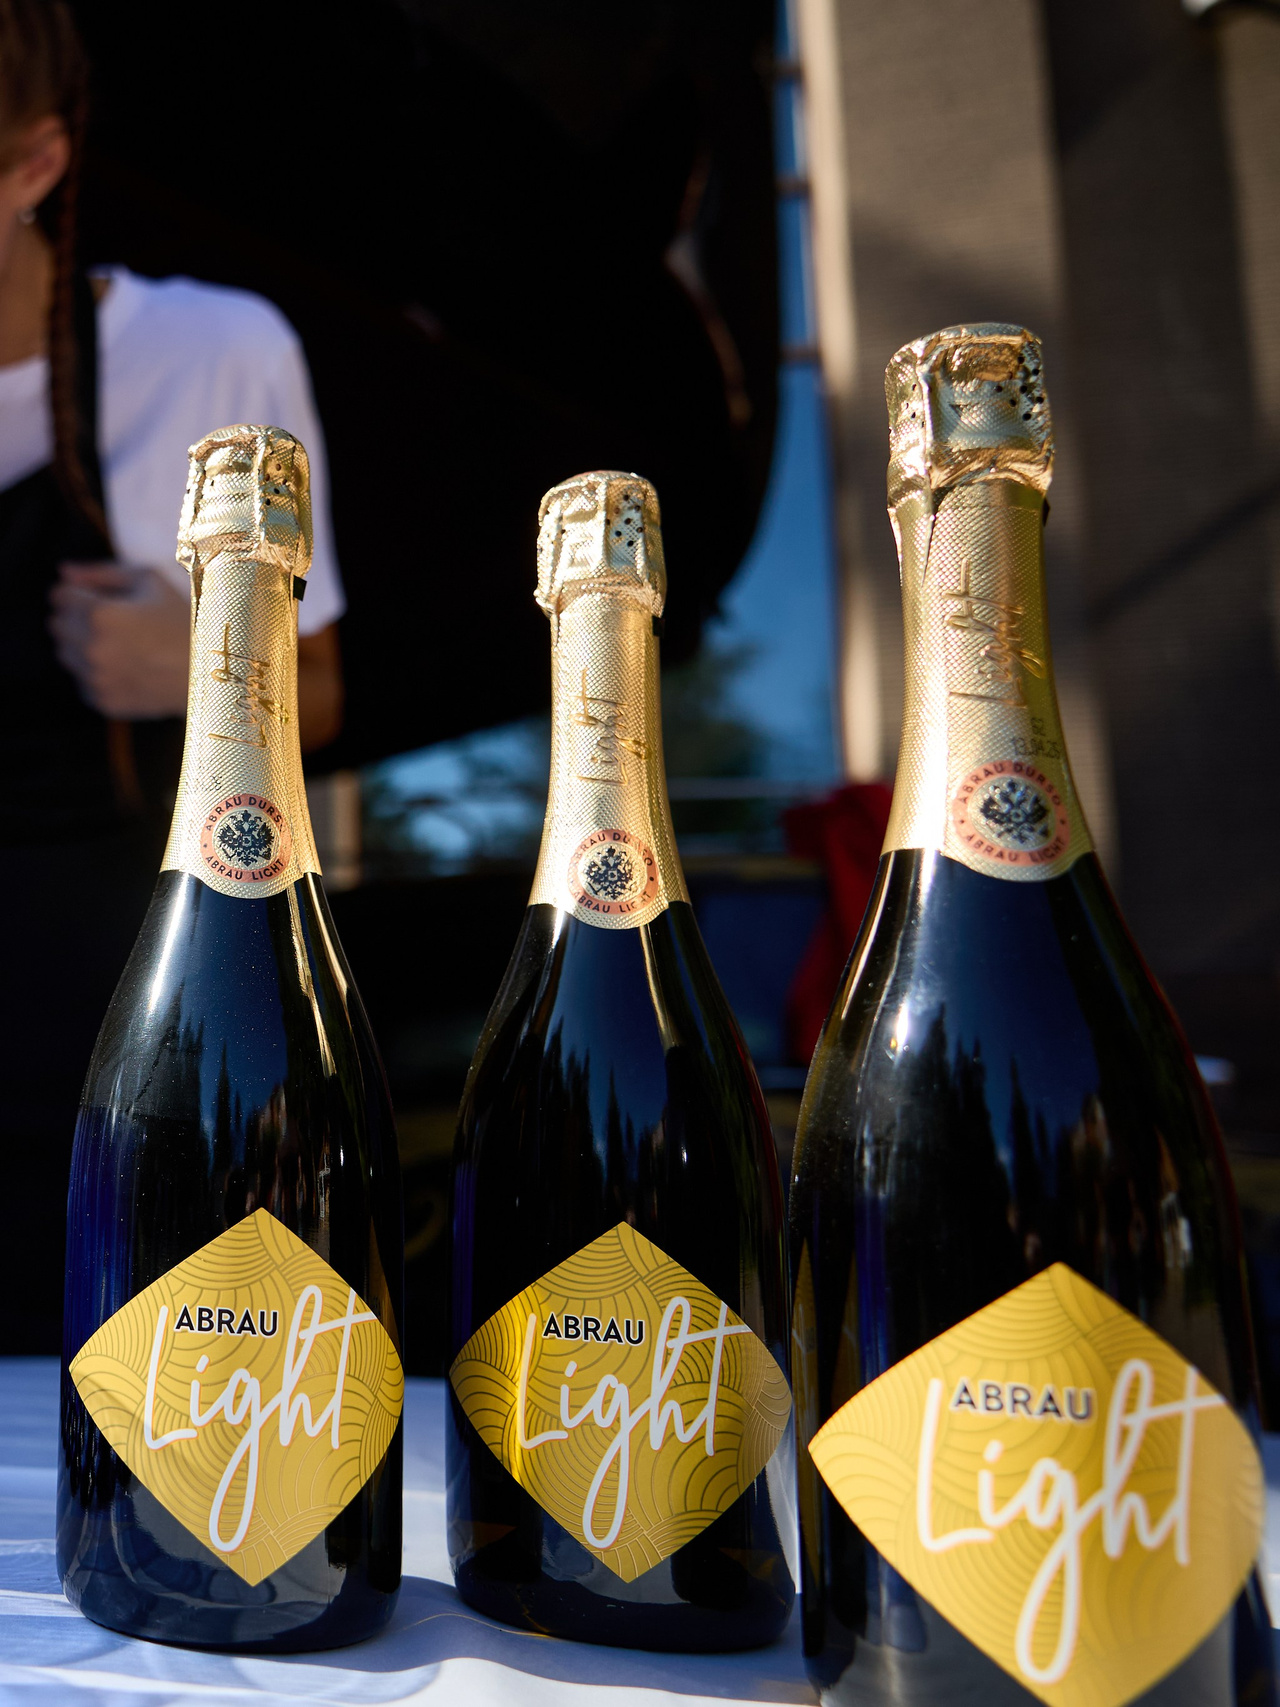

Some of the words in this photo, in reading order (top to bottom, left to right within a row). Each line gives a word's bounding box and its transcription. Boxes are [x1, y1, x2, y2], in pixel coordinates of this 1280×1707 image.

[959, 762, 1005, 804] ABRAU
[206, 796, 242, 831] ABRAU
[249, 796, 283, 832] DURS
[572, 833, 606, 867] BRAU
[612, 832, 654, 866] DUSO
[966, 834, 1018, 862] ABRAU
[205, 856, 243, 880] ABRAU
[252, 858, 284, 880] LIGHT
[175, 1304, 278, 1337] ABRAU
[543, 1312, 645, 1345] ABRAU
[950, 1378, 1096, 1421] ABRAU
[144, 1285, 378, 1552] Light
[517, 1296, 753, 1549] Light
[917, 1359, 1226, 1684] Light
